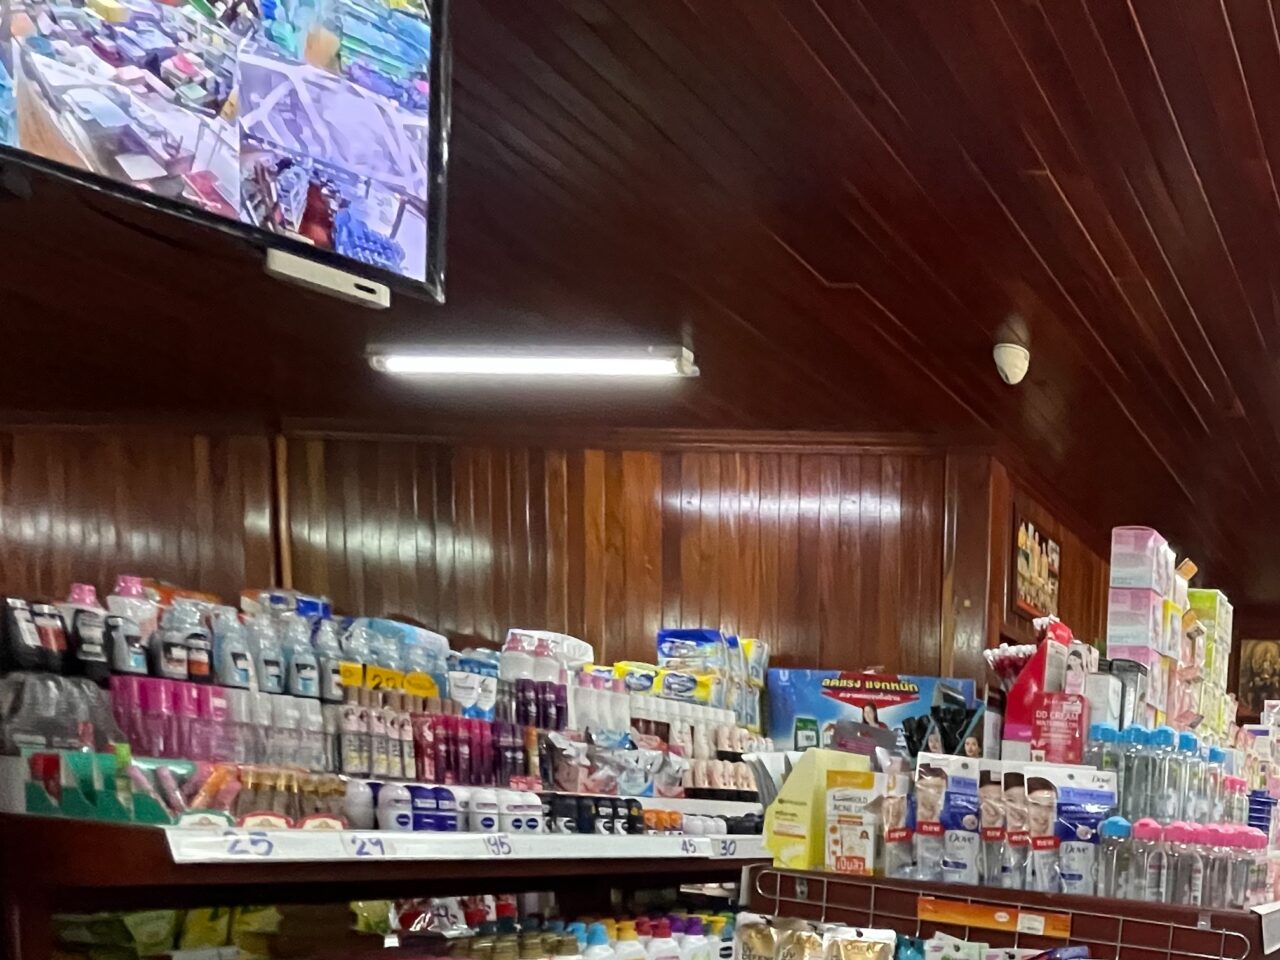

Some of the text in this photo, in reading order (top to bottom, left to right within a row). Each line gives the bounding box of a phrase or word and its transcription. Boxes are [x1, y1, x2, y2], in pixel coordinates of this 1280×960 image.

[222, 829, 274, 857] 25
[949, 833, 975, 843] Dove
[351, 837, 386, 857] 29
[681, 839, 697, 855] 45
[720, 839, 737, 857] 30
[1064, 844, 1088, 854] Dove
